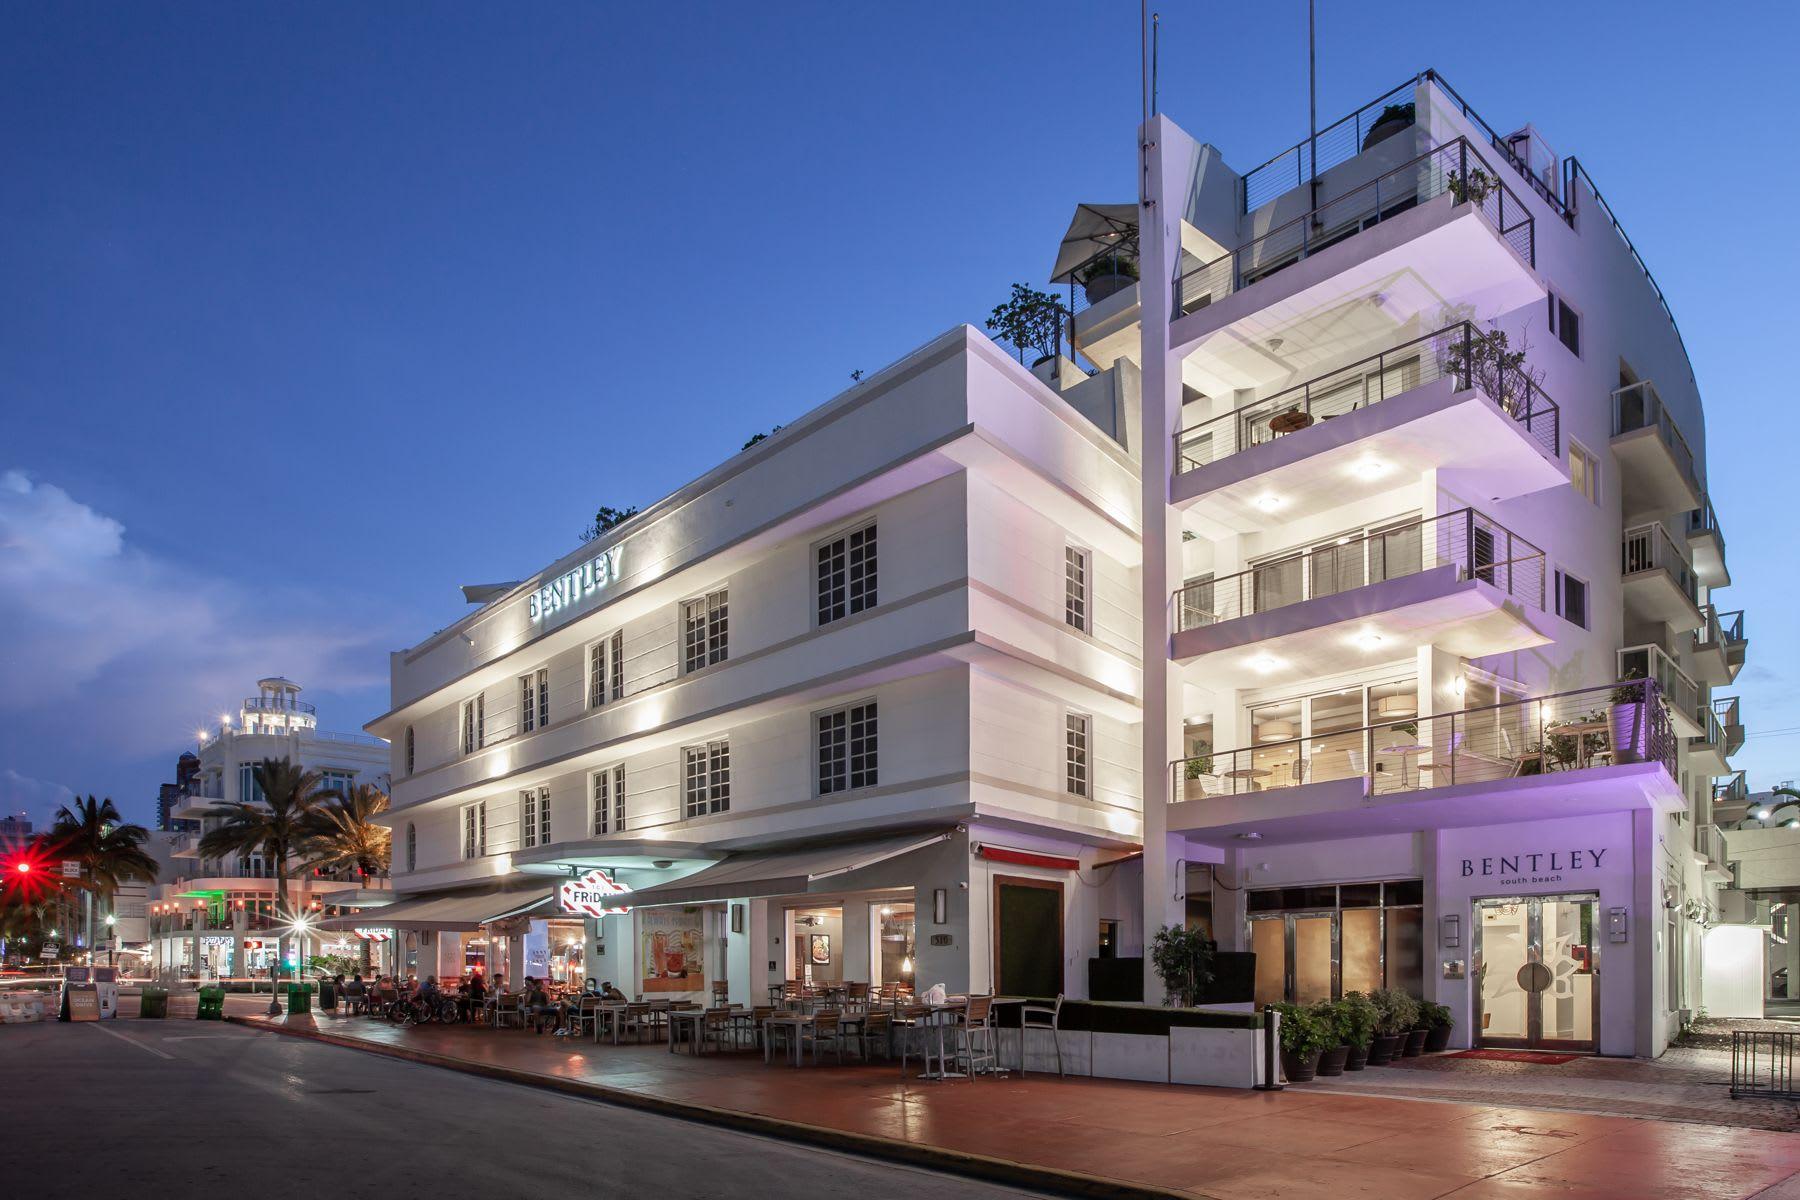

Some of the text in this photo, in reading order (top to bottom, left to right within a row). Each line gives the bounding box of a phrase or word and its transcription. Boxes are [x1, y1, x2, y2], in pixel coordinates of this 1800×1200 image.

[529, 546, 623, 619] BENTLEY
[1461, 849, 1607, 877] BENTLEY
[1500, 875, 1562, 885] south beach
